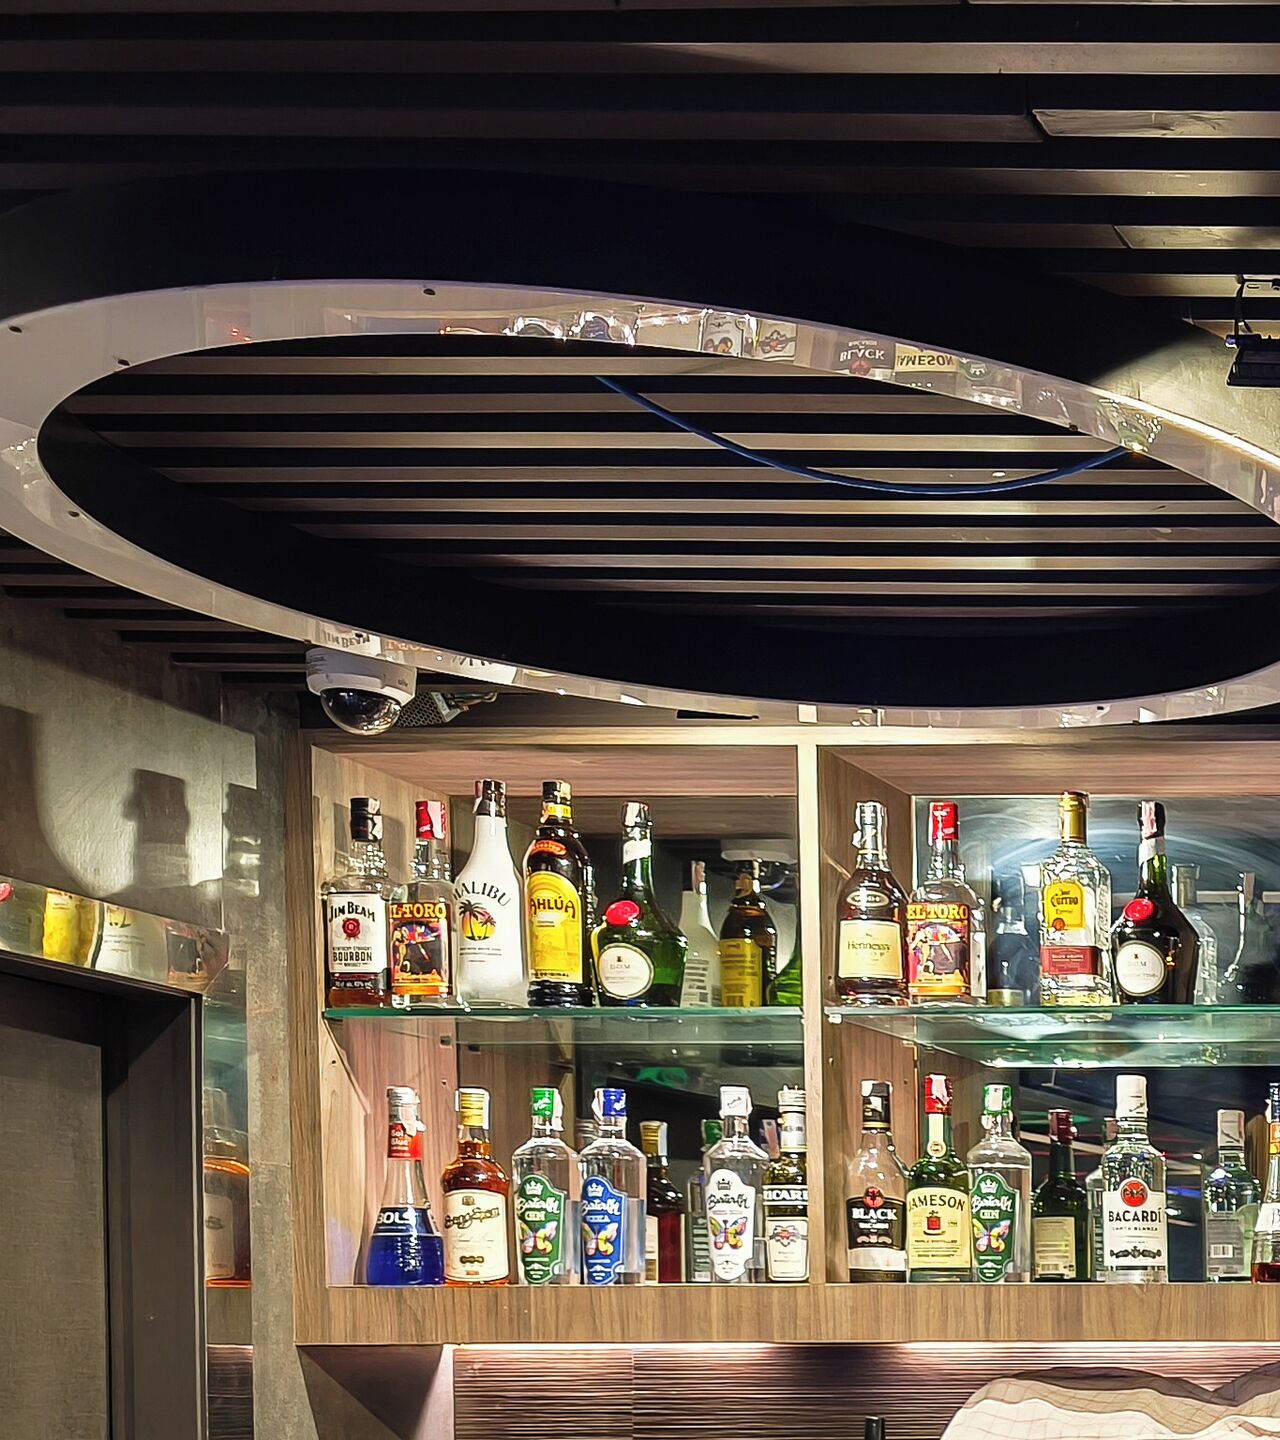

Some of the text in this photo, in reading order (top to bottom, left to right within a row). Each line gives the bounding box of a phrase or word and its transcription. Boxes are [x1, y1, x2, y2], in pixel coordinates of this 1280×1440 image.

[403, 903, 447, 918] TORO
[906, 904, 969, 920] EL TORO
[333, 951, 372, 962] BOURBON
[908, 1194, 966, 1212] JAMESON
[851, 1208, 898, 1220] BLACK
[1109, 1208, 1162, 1223] BACARDÍ
